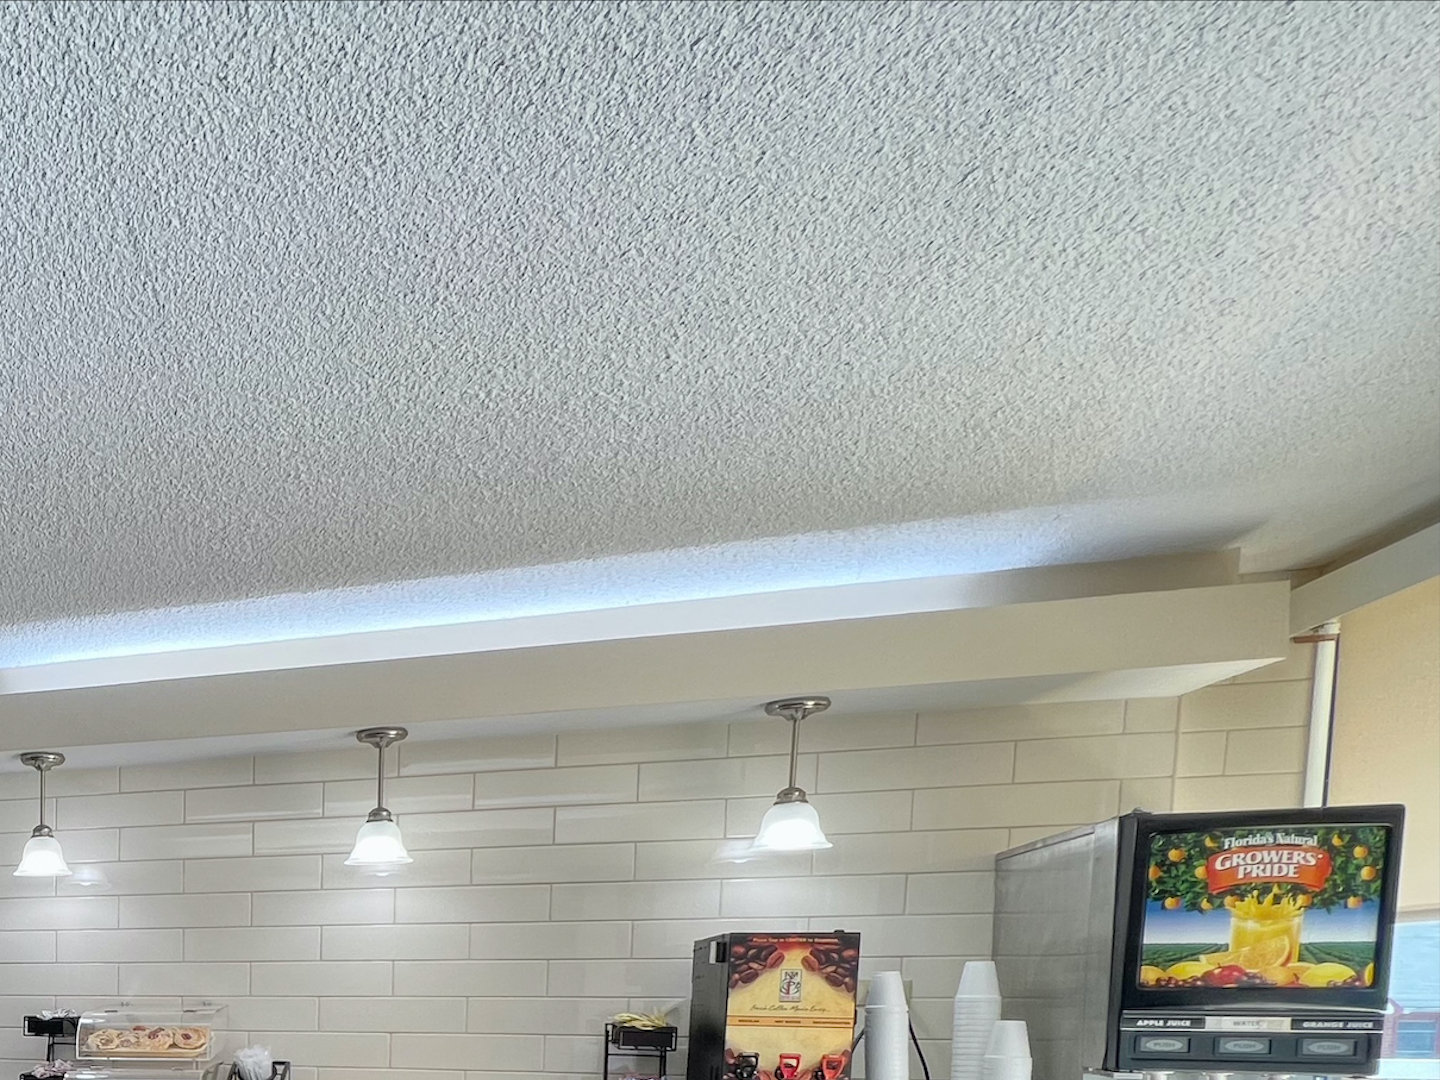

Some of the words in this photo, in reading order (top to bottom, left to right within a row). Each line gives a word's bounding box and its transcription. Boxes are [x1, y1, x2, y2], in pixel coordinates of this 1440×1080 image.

[1223, 832, 1274, 850] Florida's
[1275, 832, 1318, 847] Natural
[1237, 863, 1299, 879] PRIDE
[1136, 1019, 1164, 1027] APPLE
[1166, 1019, 1192, 1027] JUICE
[1302, 1021, 1344, 1029] ORANGE
[1346, 1021, 1373, 1029] JUICE
